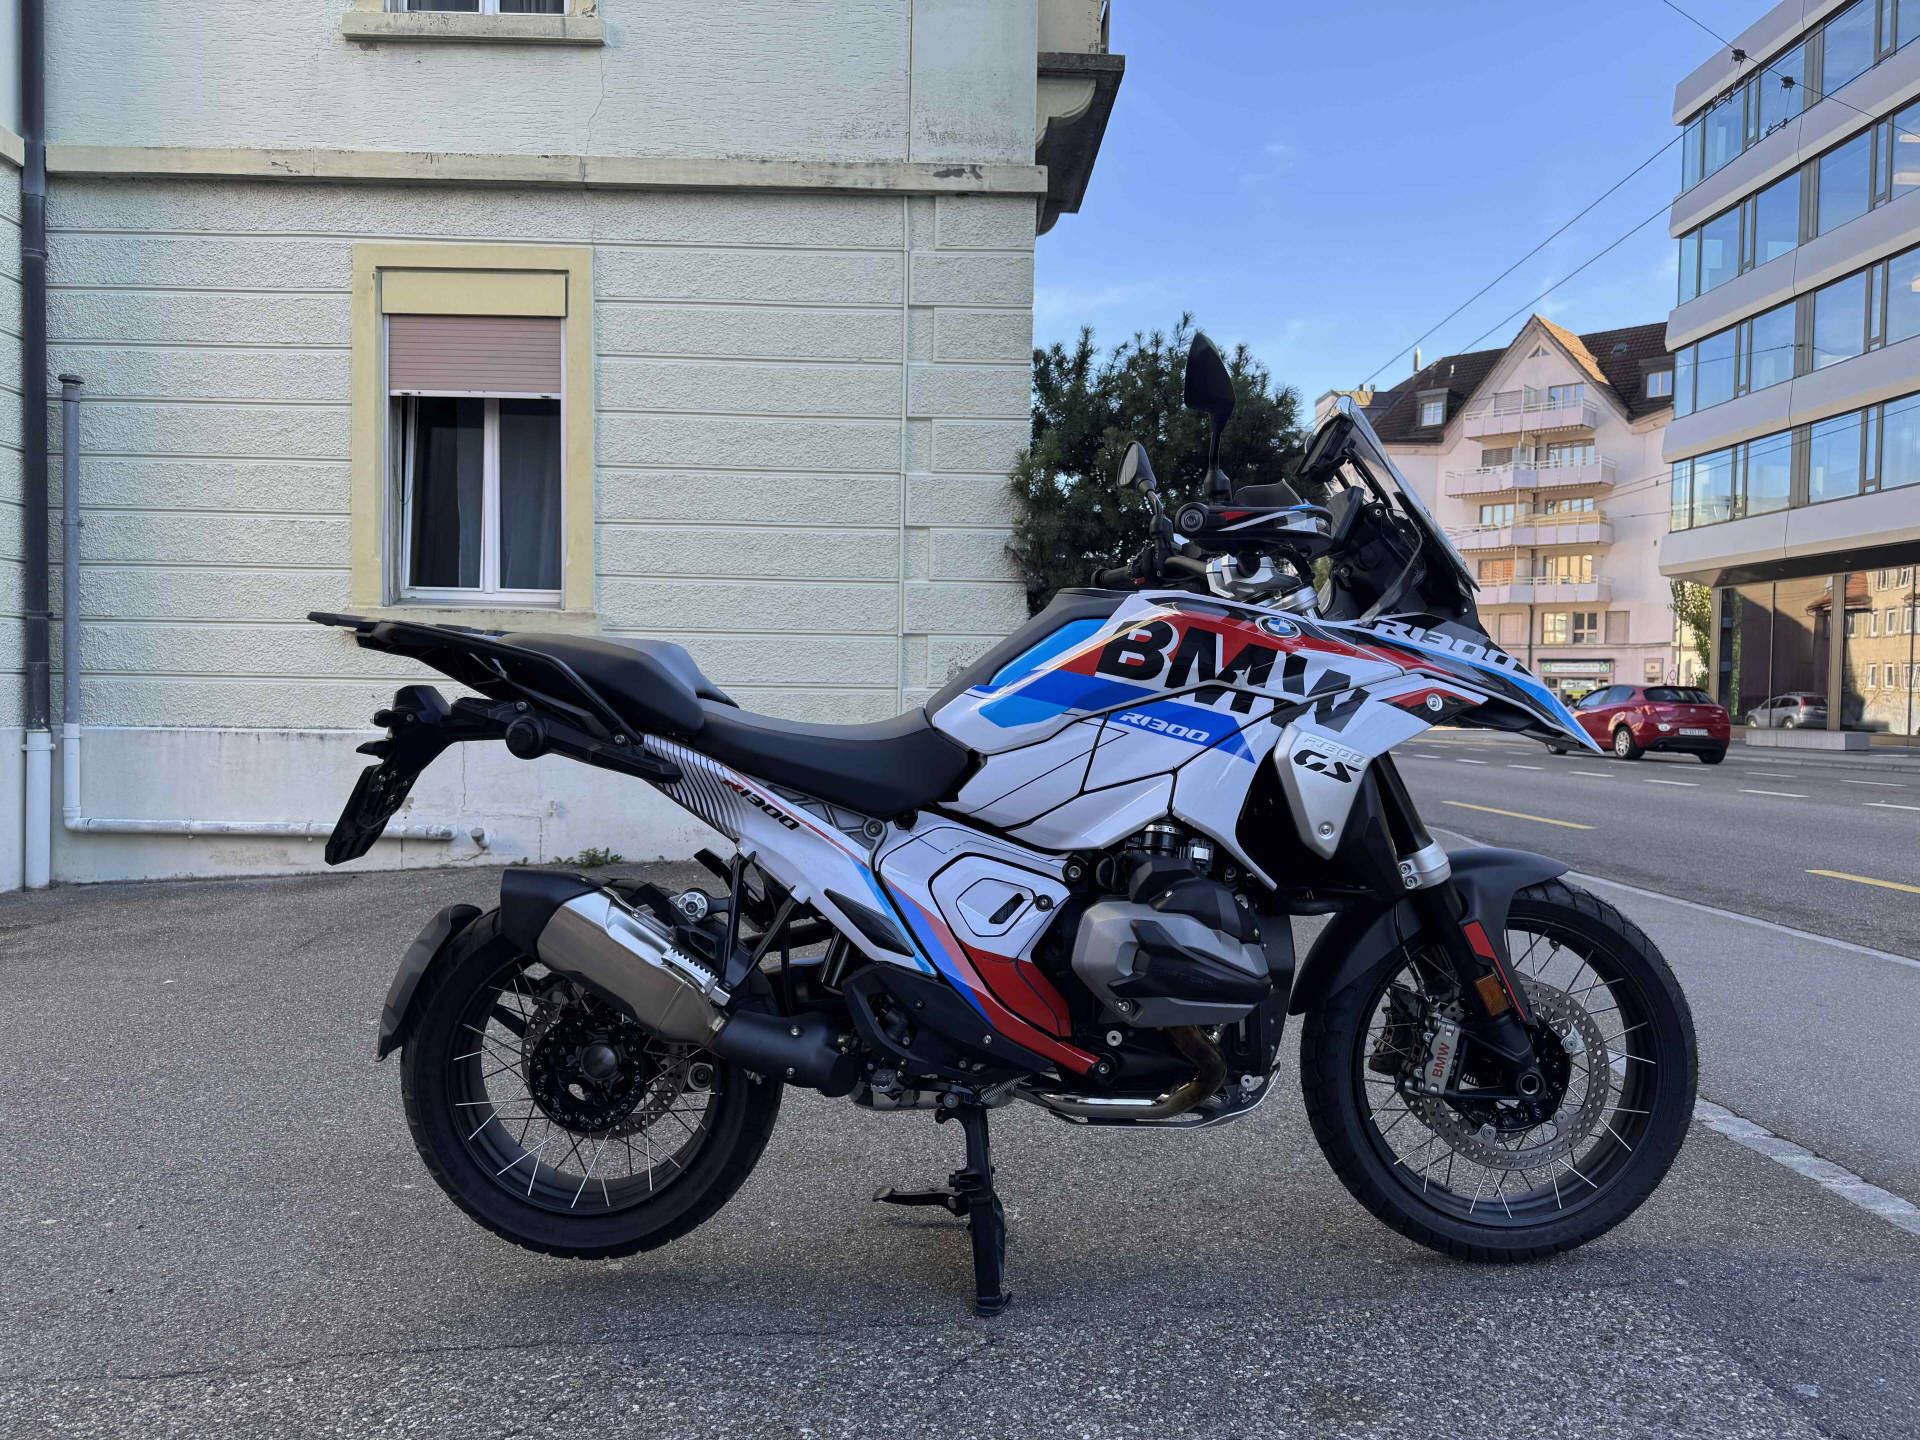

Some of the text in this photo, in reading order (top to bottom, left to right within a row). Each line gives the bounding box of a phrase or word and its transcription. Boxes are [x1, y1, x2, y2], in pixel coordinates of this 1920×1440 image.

[1095, 620, 1371, 733] BMW
[1120, 712, 1209, 742] R1300
[1294, 749, 1362, 783] GS
[722, 779, 800, 830] R1300
[1432, 1042, 1450, 1078] BMW
